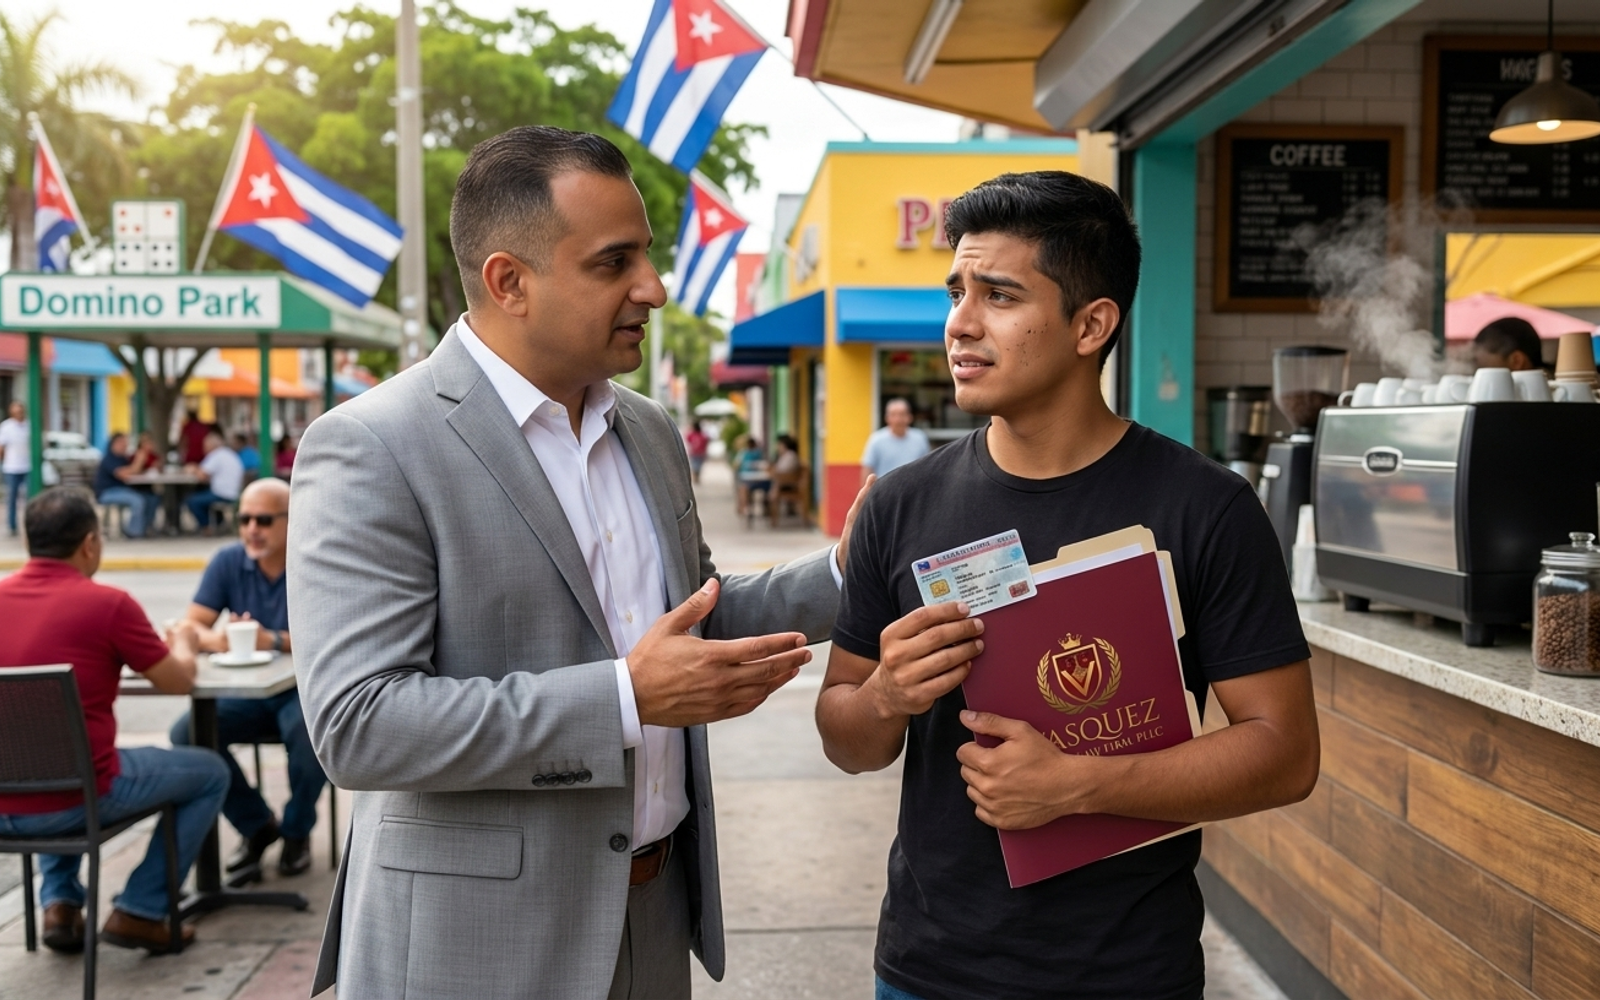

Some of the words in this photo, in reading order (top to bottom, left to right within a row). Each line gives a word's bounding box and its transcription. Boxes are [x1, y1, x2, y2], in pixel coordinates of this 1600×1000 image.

[1270, 144, 1347, 166] COFFEE
[19, 285, 164, 316] Domino
[178, 286, 262, 316] Park
[1042, 697, 1161, 749] ASQUEZ
[1136, 725, 1164, 743] PLLC
